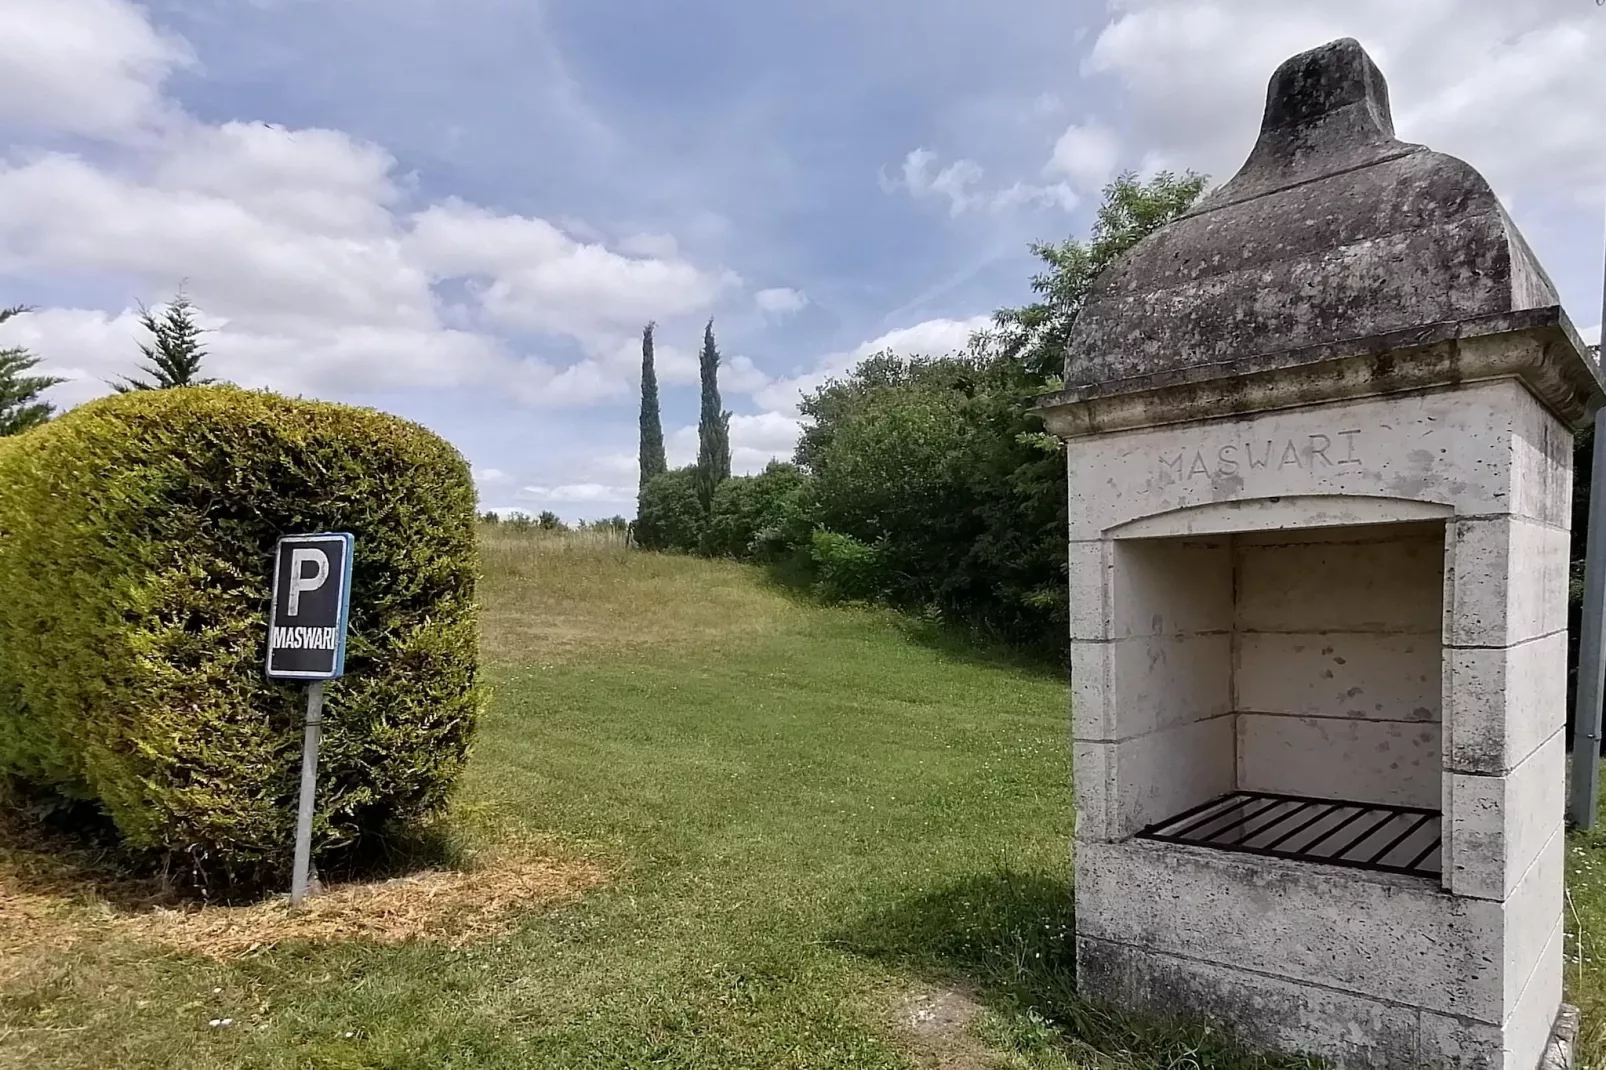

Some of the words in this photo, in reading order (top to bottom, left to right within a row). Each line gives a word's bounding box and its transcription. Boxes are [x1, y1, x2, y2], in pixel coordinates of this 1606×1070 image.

[1158, 429, 1363, 482] MASWARI
[287, 548, 330, 616] P
[272, 626, 336, 650] MASWARI
